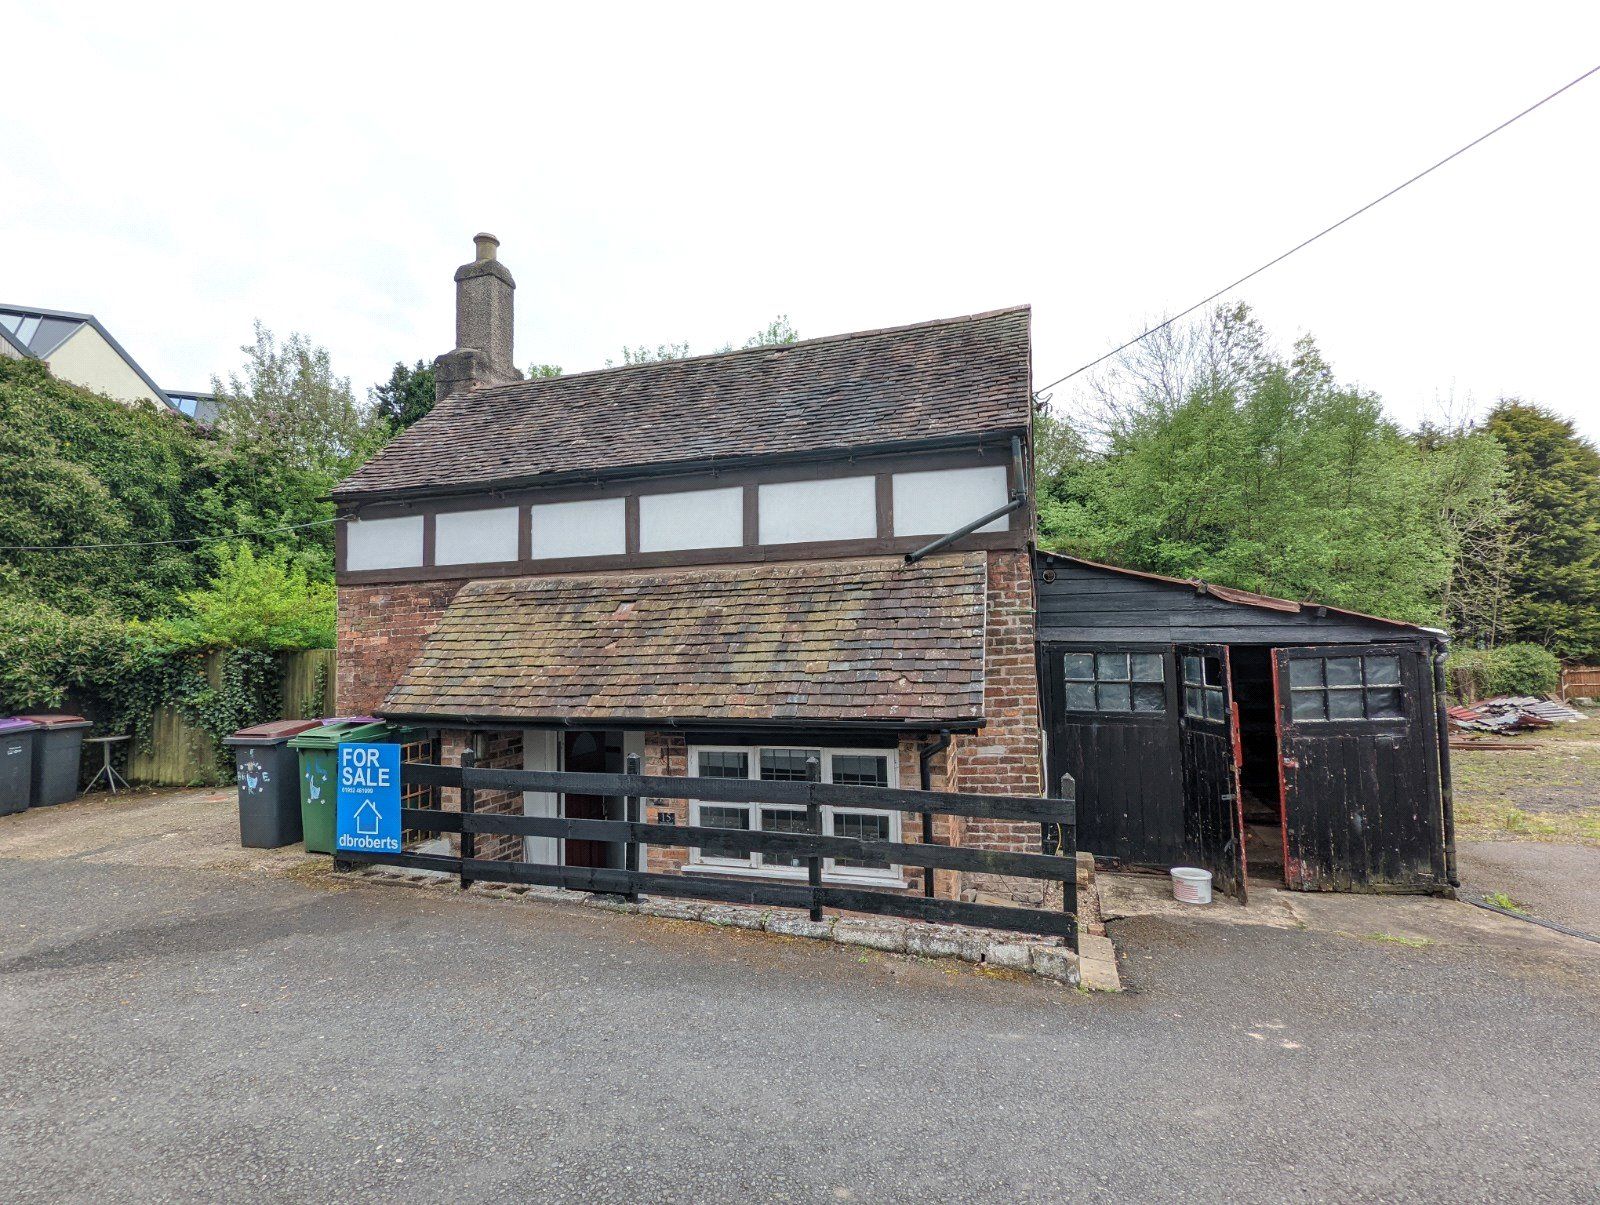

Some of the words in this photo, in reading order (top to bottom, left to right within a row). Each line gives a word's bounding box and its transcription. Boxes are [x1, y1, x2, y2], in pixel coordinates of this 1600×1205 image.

[342, 748, 380, 767] FOR
[342, 767, 390, 786] SALE
[339, 834, 399, 850] dbroberts
